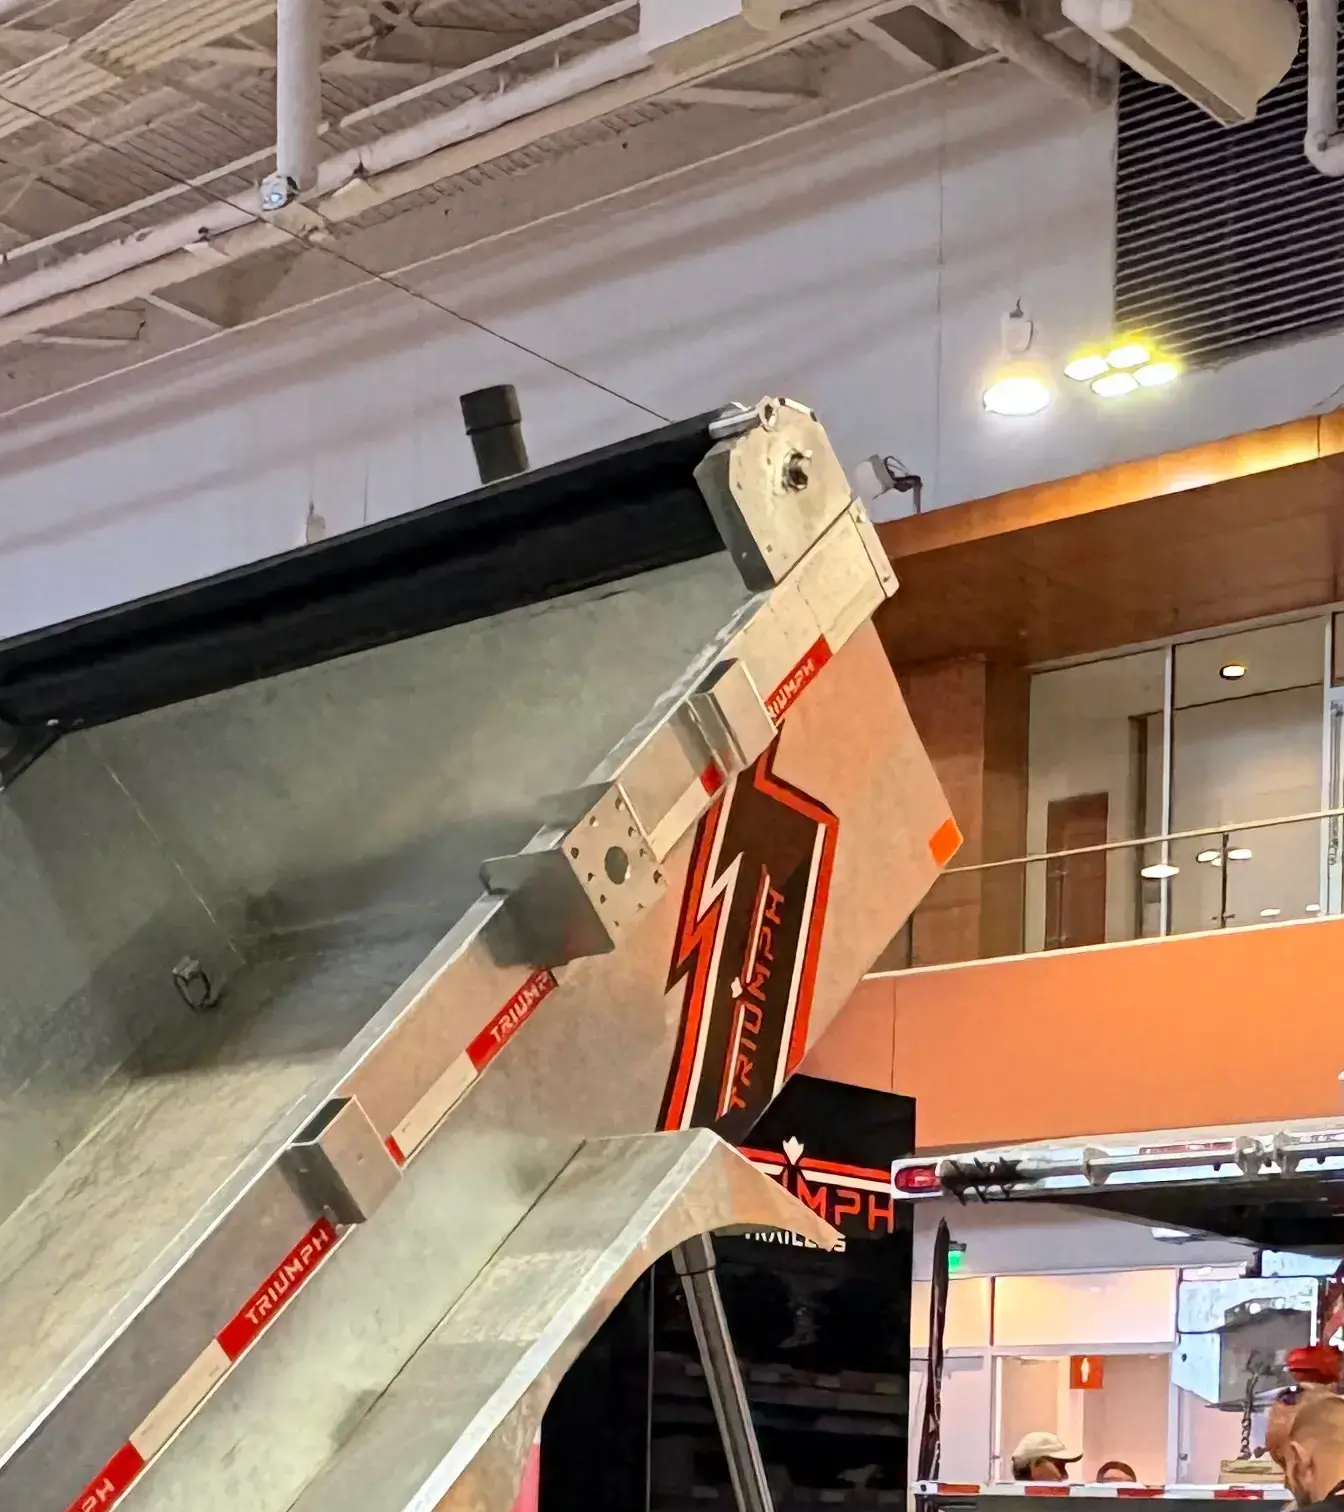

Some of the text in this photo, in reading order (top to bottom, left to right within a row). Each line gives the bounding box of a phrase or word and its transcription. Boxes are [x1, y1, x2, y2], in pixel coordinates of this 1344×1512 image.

[766, 658, 816, 719] RIUMPH
[489, 970, 550, 1043] TRIUMP
[729, 886, 785, 1109] TRIUMPH
[243, 1228, 329, 1325] TRIUMPH
